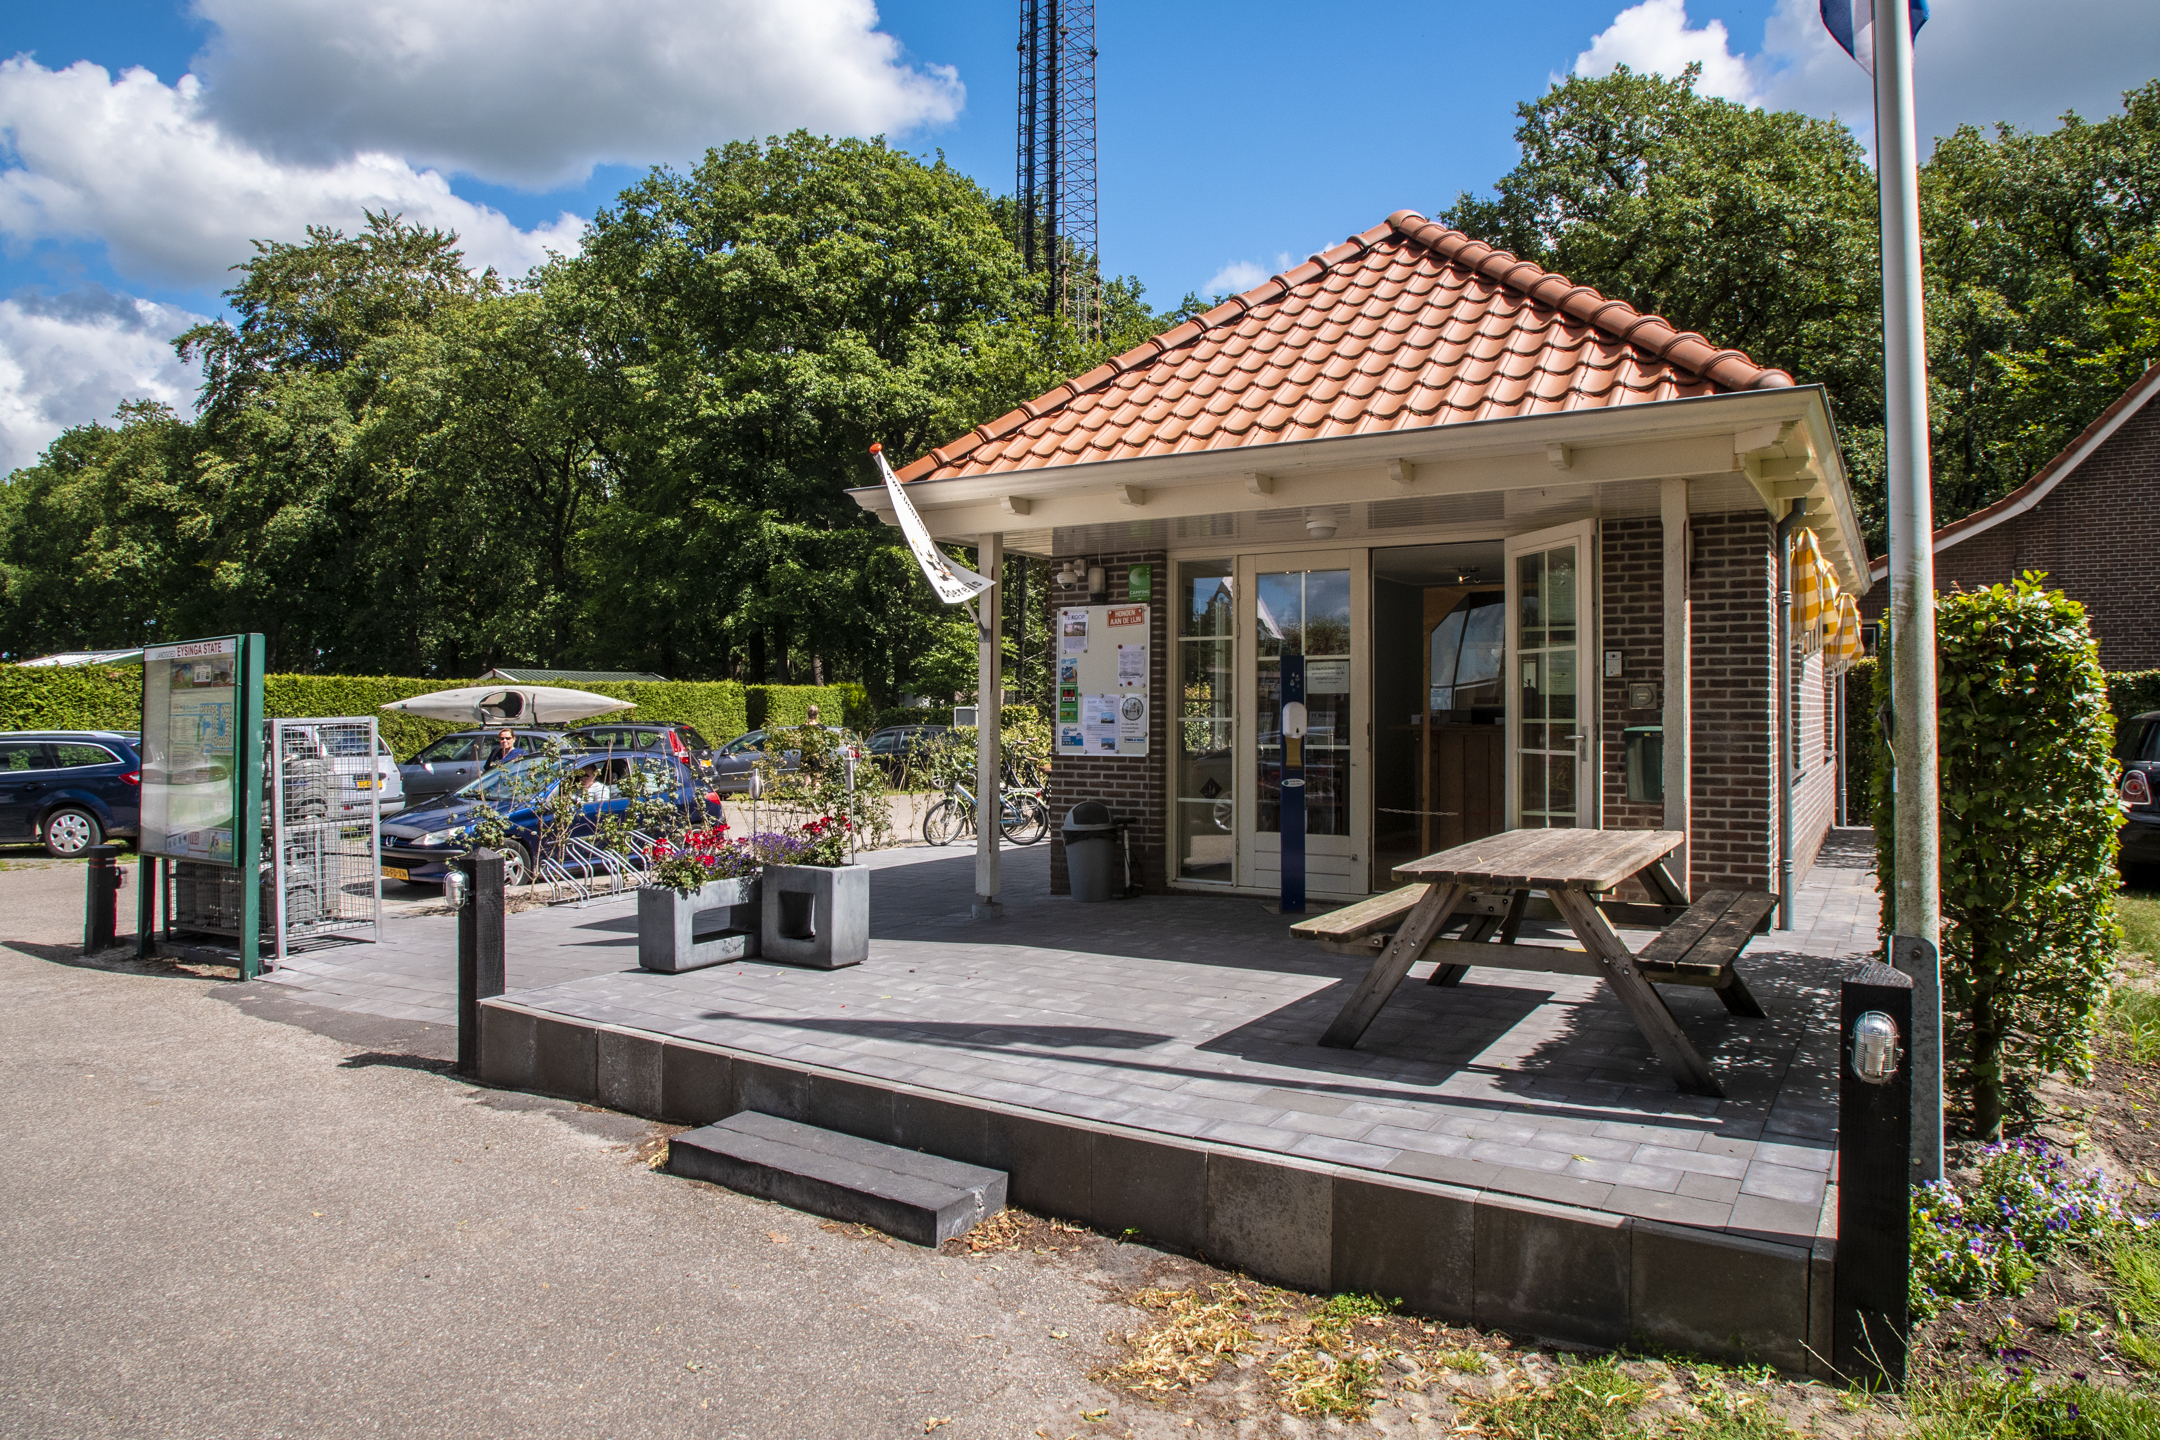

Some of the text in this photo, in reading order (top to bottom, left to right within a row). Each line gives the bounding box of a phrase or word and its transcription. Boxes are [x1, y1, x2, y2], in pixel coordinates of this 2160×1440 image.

[1114, 609, 1135, 617] HONDEN
[177, 644, 203, 657] EYSINGA
[203, 642, 222, 654] STATE
